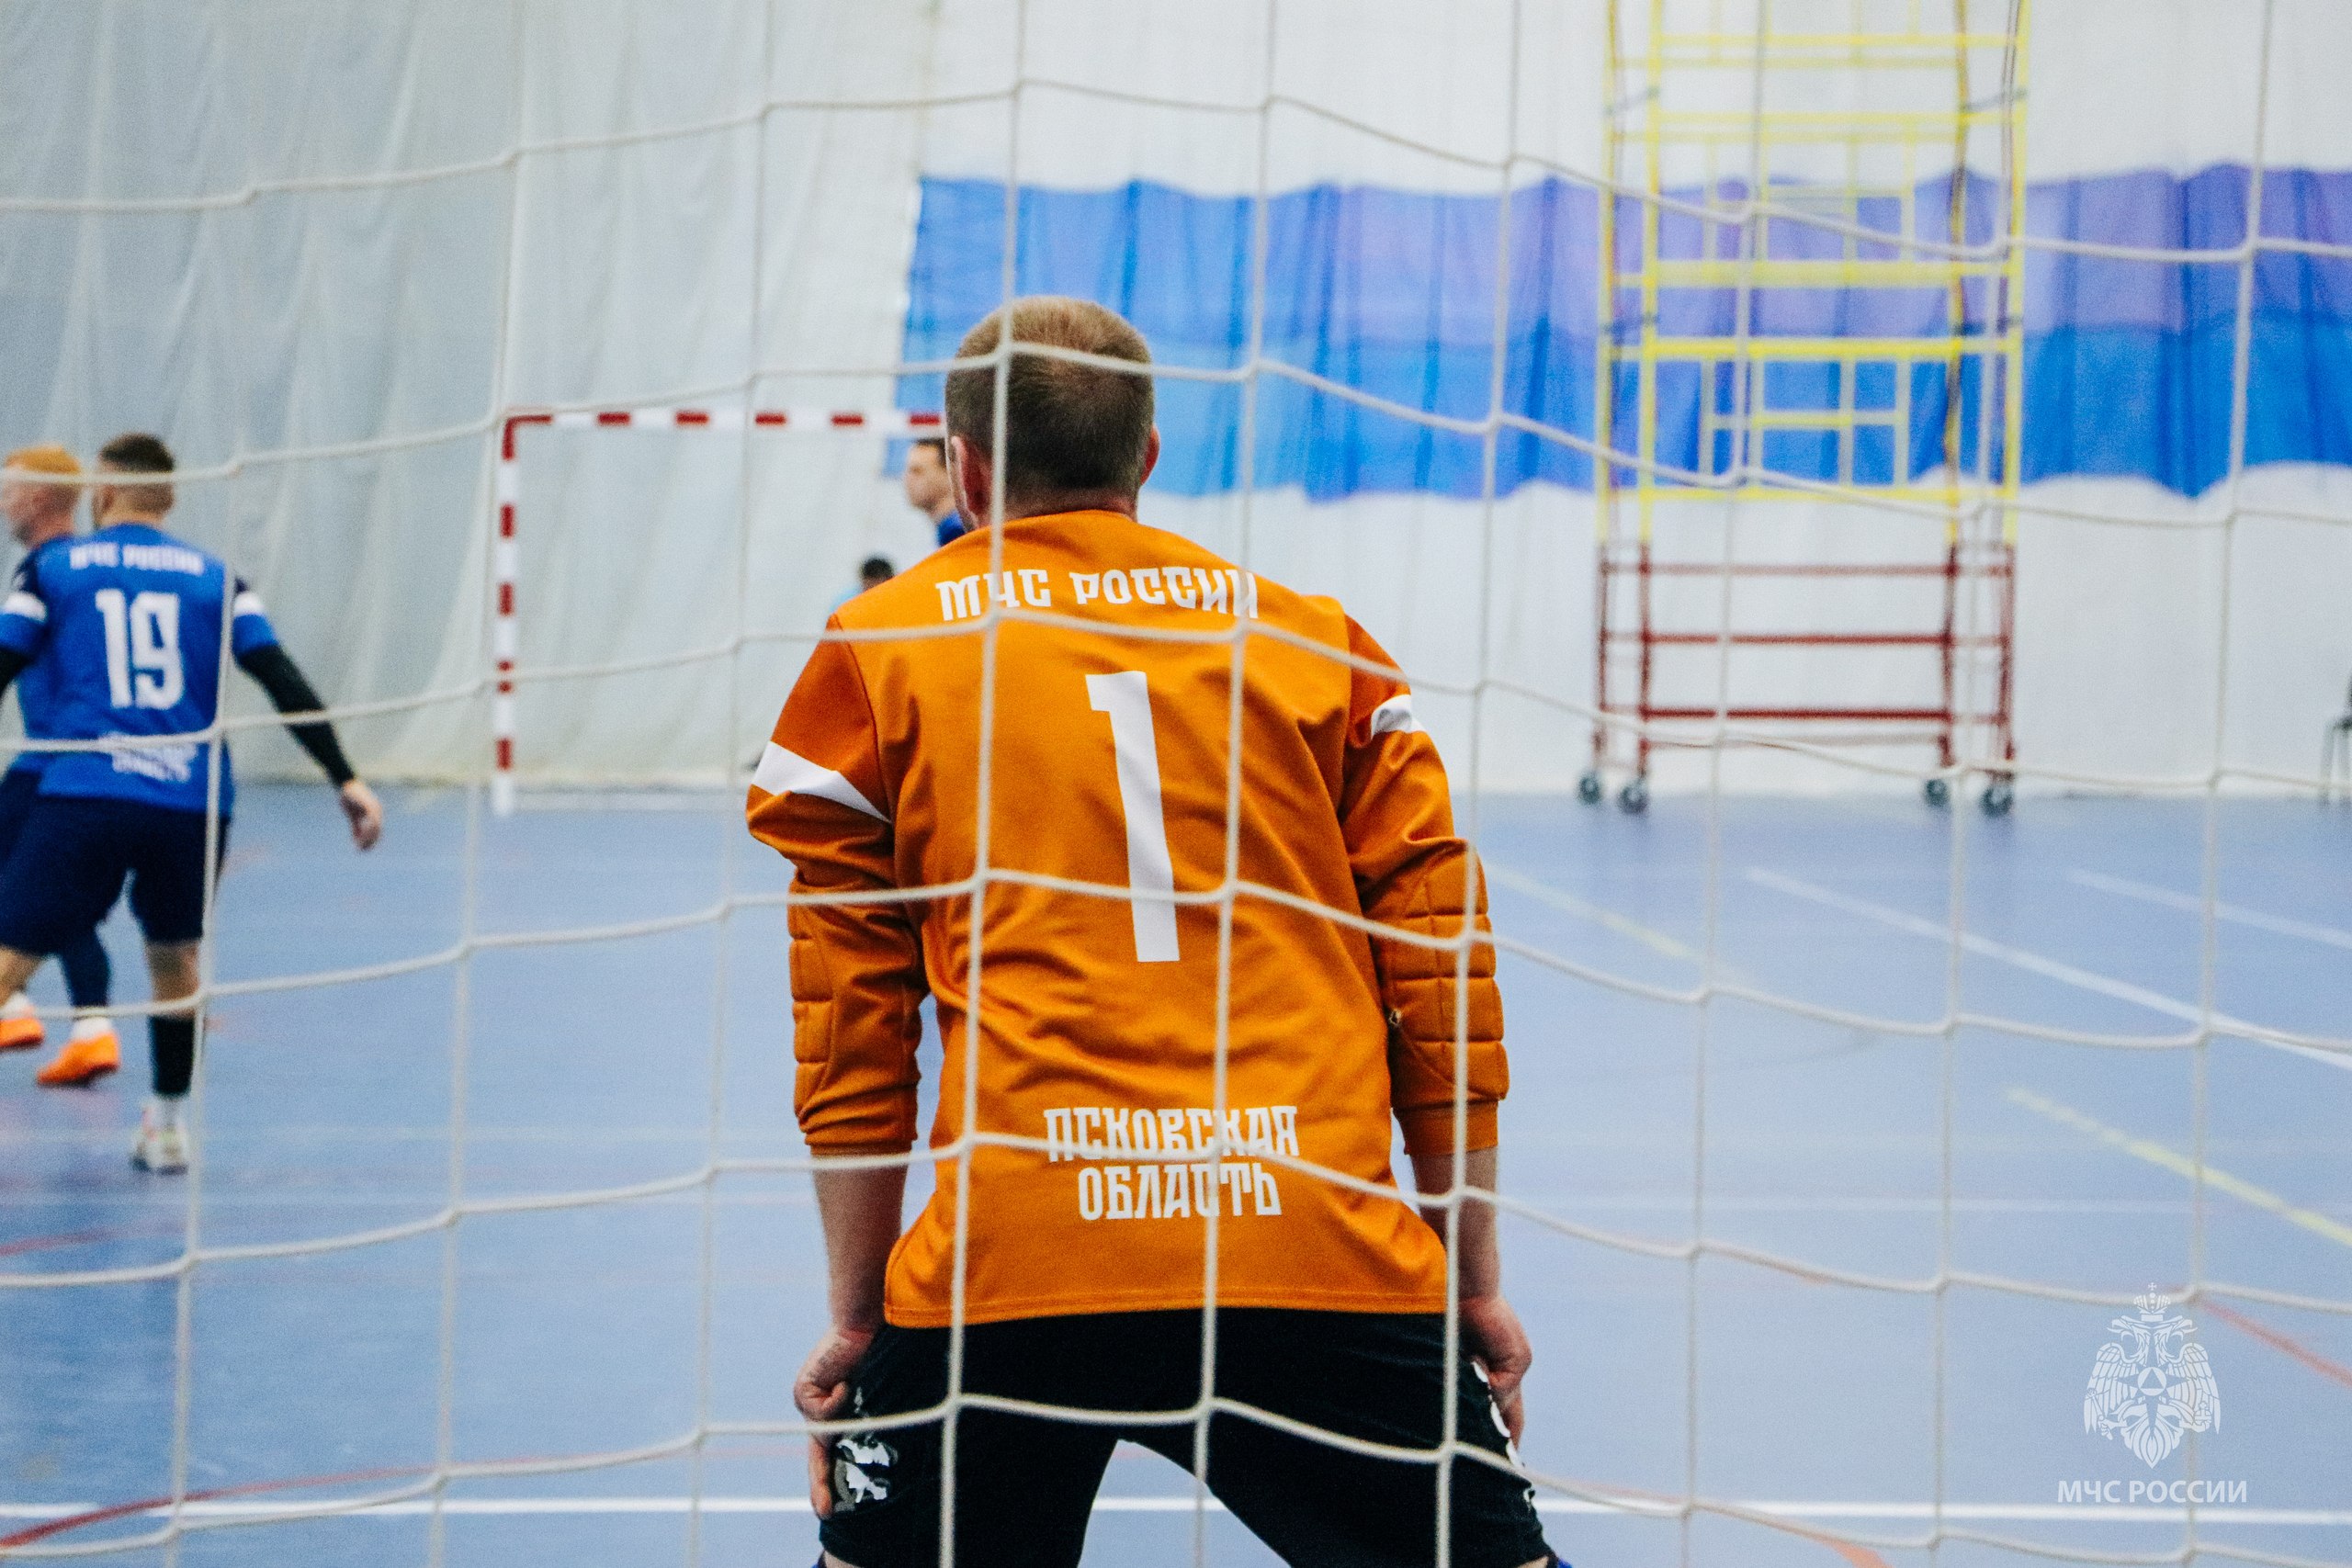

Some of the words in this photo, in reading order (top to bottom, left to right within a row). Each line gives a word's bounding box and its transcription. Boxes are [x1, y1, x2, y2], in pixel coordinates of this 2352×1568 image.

[935, 568, 1052, 621] МЧС
[1069, 566, 1258, 619] РОССИИ
[95, 589, 185, 710] 19
[1085, 671, 1181, 963] 1
[1043, 1105, 1299, 1162] ПСКОВСКАЯ
[1078, 1163, 1282, 1221] ОБЛАСТЬ
